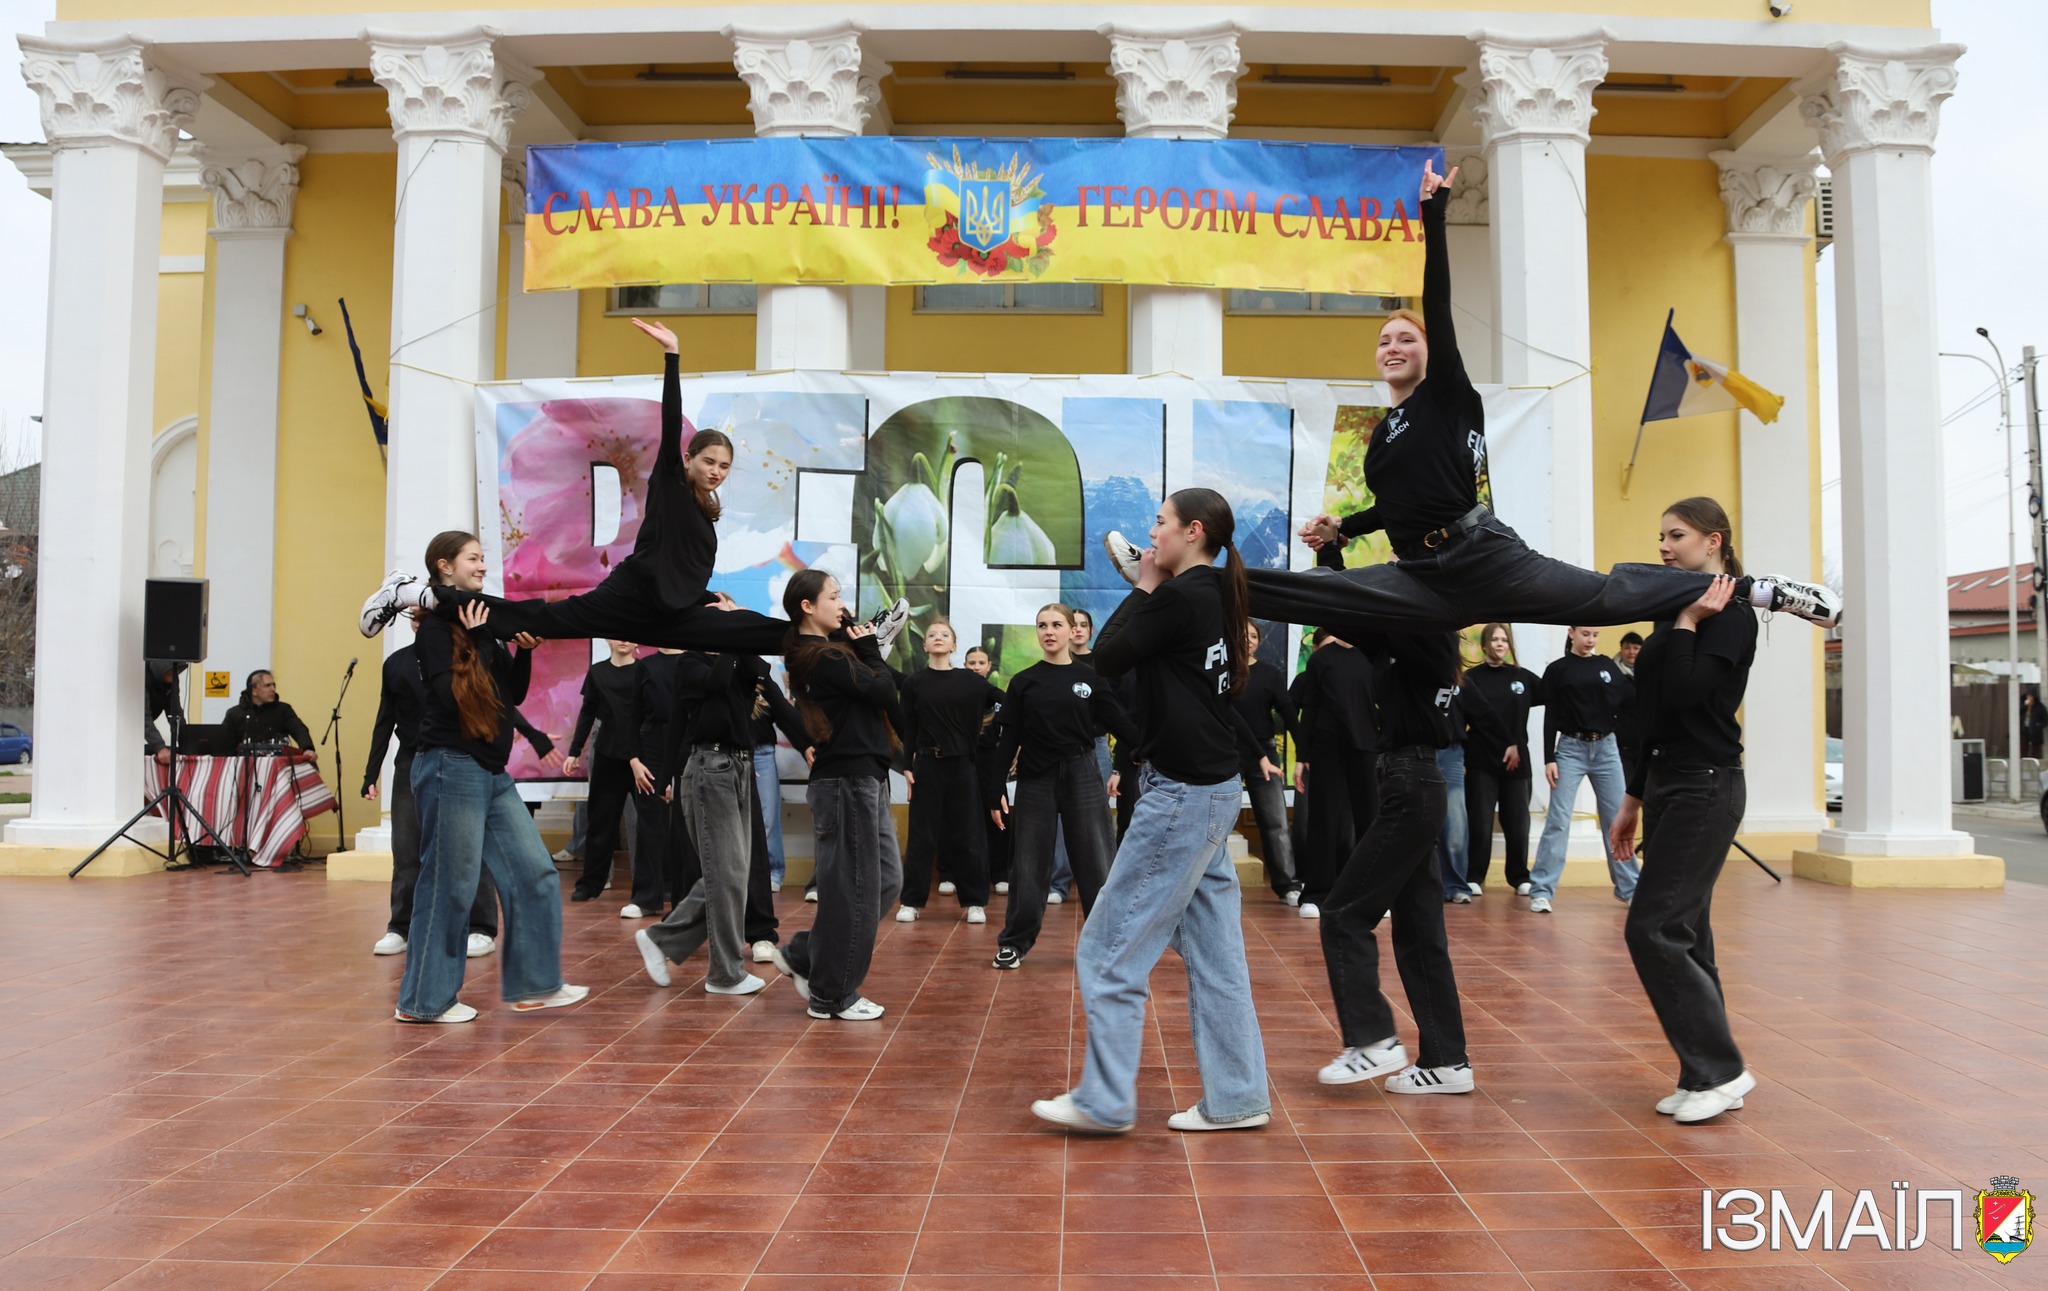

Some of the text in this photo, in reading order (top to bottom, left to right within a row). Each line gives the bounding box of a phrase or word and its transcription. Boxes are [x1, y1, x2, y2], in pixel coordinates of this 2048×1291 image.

[543, 173, 900, 236] СЛАВА УКРАЇНІ!
[1077, 184, 1426, 244] ГЕРОЯМ СЛАВА!
[1385, 420, 1410, 443] COACH
